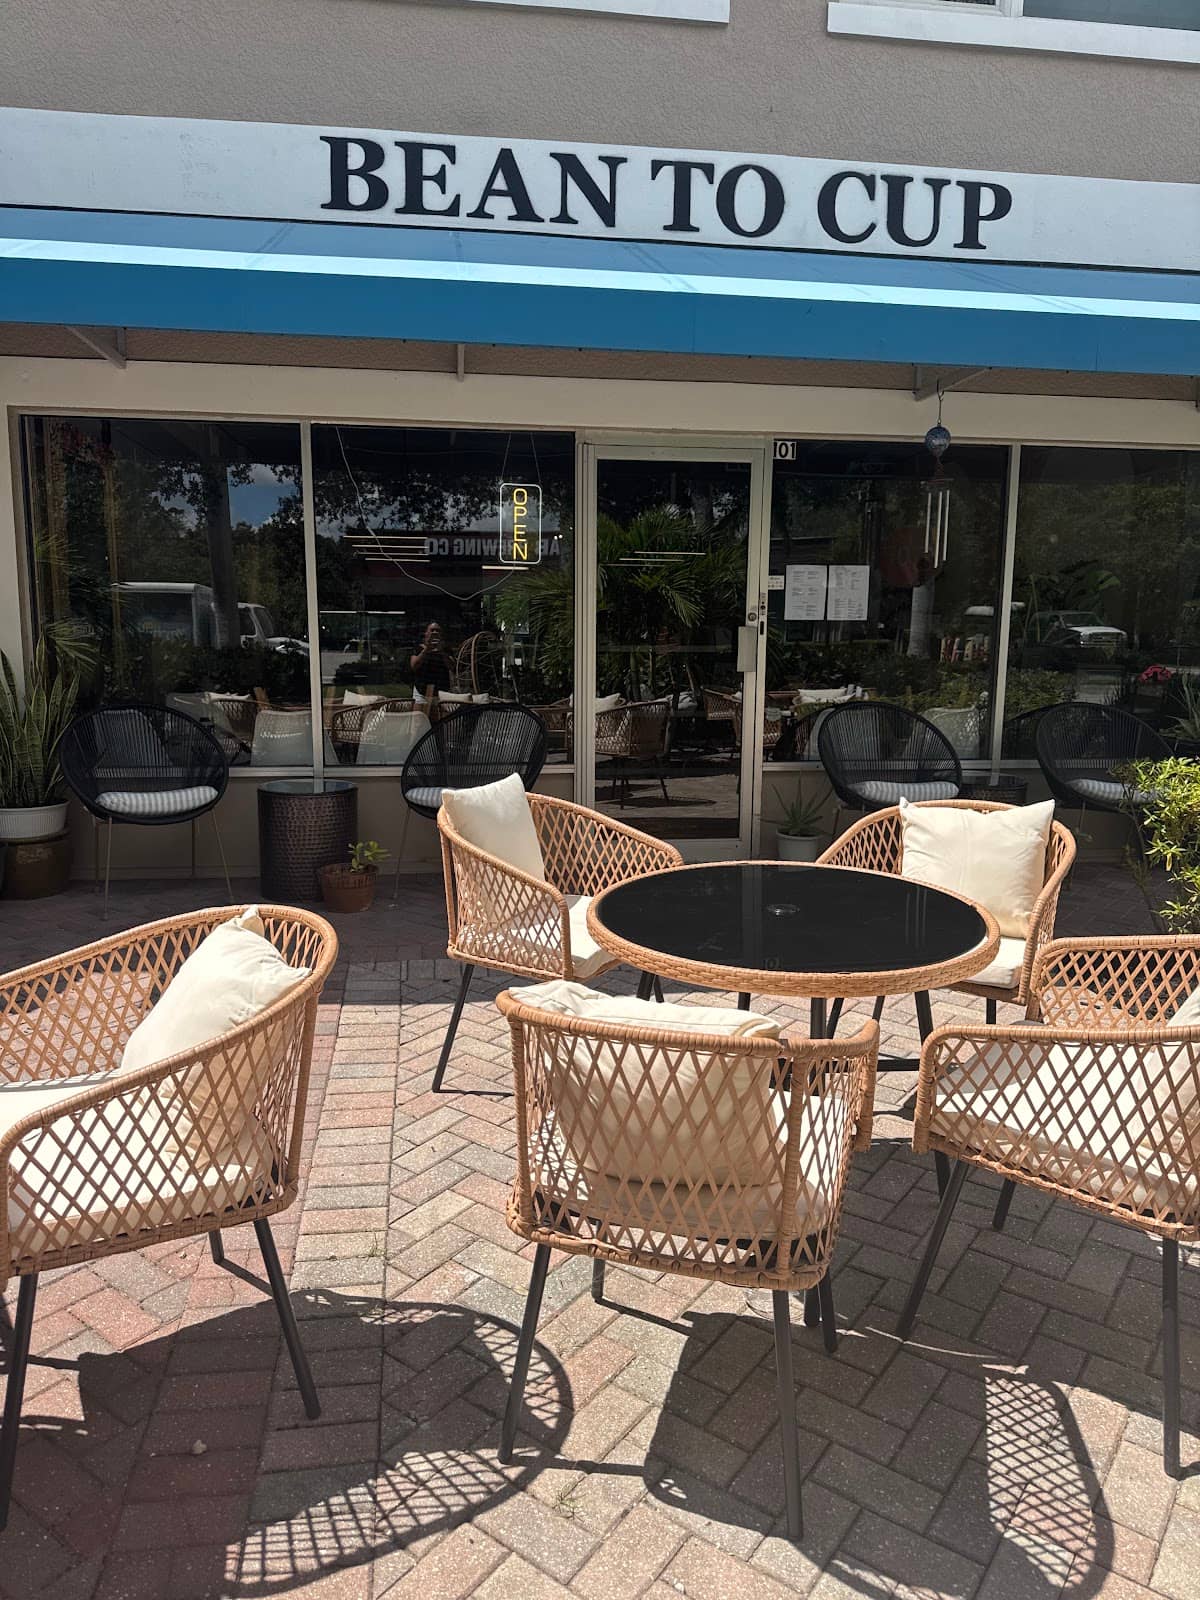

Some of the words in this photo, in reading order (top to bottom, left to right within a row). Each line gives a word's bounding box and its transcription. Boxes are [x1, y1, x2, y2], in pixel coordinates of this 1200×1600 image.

[320, 135, 628, 228] BEAN
[651, 159, 785, 238] TO
[816, 170, 1013, 250] CUP
[774, 441, 796, 459] 101
[513, 488, 528, 561] OPEN
